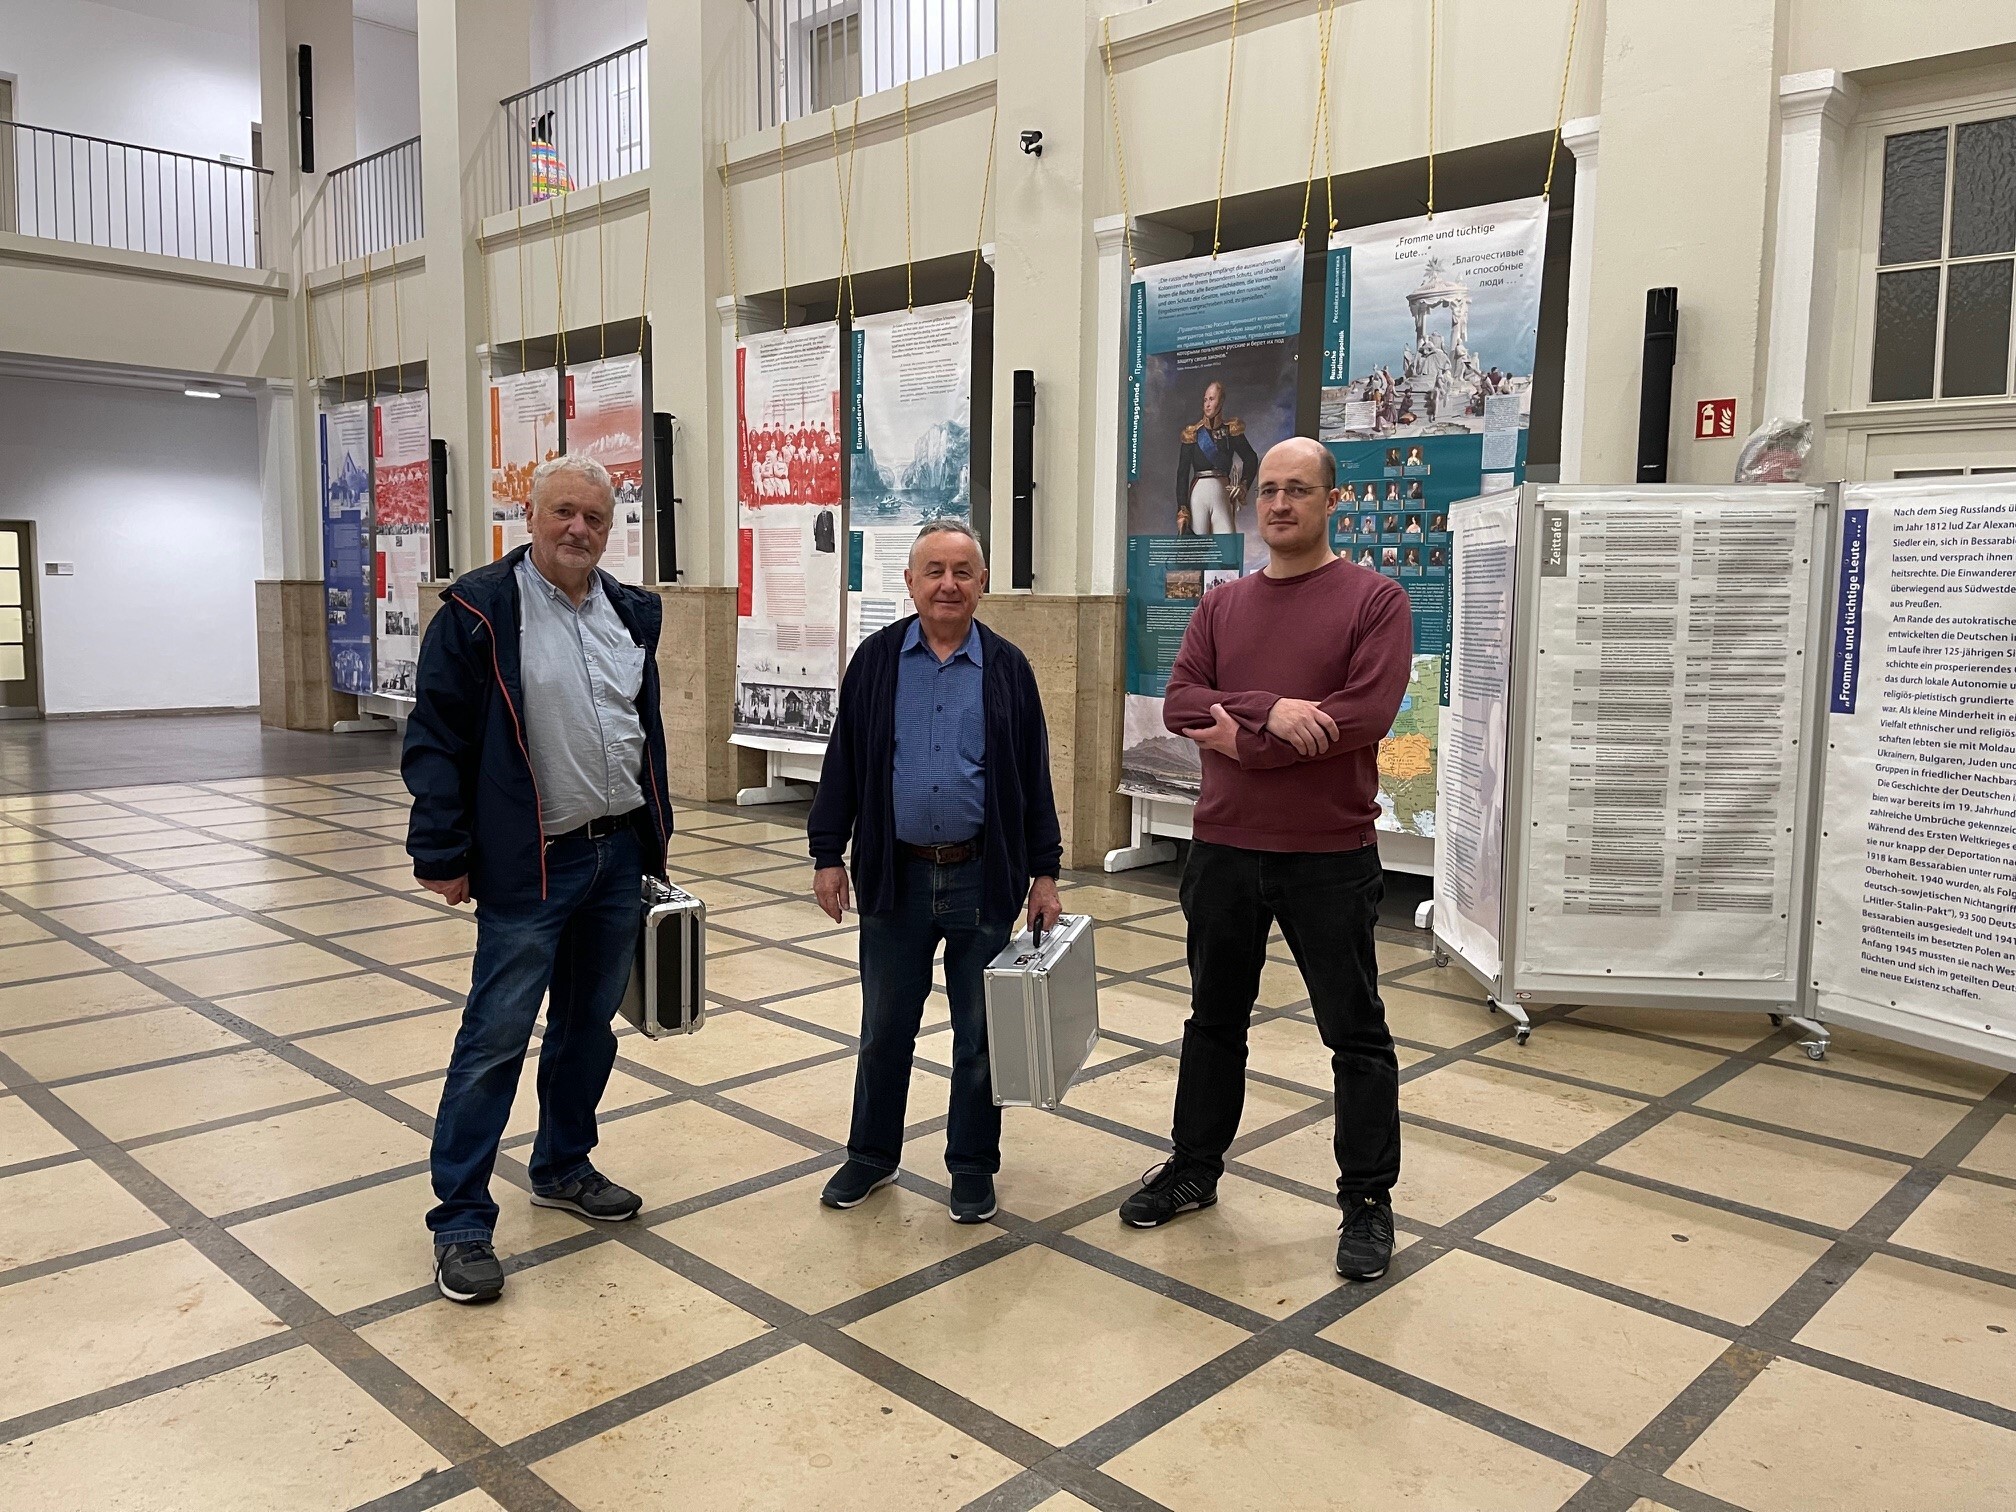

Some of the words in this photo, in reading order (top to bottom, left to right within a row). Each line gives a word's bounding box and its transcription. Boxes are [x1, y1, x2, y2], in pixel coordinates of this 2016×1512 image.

[1436, 228, 1454, 240] und
[1456, 223, 1496, 237] tüchtige
[1473, 262, 1524, 275] способные
[1479, 279, 1504, 288] люди
[1337, 330, 1345, 380] Siedlungspolitik
[1131, 382, 1140, 474] Auswanderungsgründe
[1894, 508, 1915, 516] Nach
[1917, 507, 1937, 515] dem
[1939, 507, 1958, 517] Sieg
[1960, 504, 2006, 514] Russlands
[1905, 522, 1924, 533] Jahr
[1925, 521, 1947, 531] 1812
[1949, 521, 1964, 531] lud
[1965, 521, 1981, 530] Zar
[1550, 518, 1562, 566] Zeittafel
[1893, 537, 1921, 547] Siedler
[1922, 537, 1939, 548] ein,
[1940, 536, 1958, 546] sich
[1959, 536, 1969, 546] in
[1848, 540, 1860, 574] Leute
[1893, 554, 1919, 562] lassen,
[1921, 553, 1938, 561] und
[1939, 551, 1984, 564] versprach
[1986, 552, 2013, 561] ihnen
[1891, 569, 1939, 577] heitsrechte.
[1941, 569, 1956, 577] Die
[1891, 583, 1945, 595] überwiegend
[1946, 585, 1963, 593] aus
[1845, 574, 1860, 626] tüchtige
[1905, 599, 1942, 608] Preußen.
[1893, 613, 1906, 623] Am
[1907, 613, 1934, 624] Rande
[1935, 615, 1950, 624] des
[1843, 628, 1855, 650] und
[1888, 628, 1940, 640] entwickelten
[1940, 630, 1955, 640] die
[1957, 630, 2008, 641] Deutschen
[1887, 644, 1897, 653] im
[1898, 644, 1922, 654] Laufe
[1922, 644, 1943, 655] ihrer
[1944, 645, 2004, 660] 125-jährigen
[1886, 659, 1919, 669] schichte
[1919, 661, 1932, 670] ein
[1934, 661, 2012, 675] prosperierendes
[1885, 674, 1899, 683] das
[1899, 674, 1923, 685] durch
[1925, 676, 1949, 686] lokale
[1951, 677, 2007, 689] Autonomie
[1884, 690, 1958, 705] religiös-pietistisch
[1959, 693, 2014, 707] grundierte
[1899, 706, 1911, 714] Als
[1913, 706, 1937, 717] kleine
[1938, 707, 1995, 720] Minderheit
[1996, 710, 2006, 721] in
[1881, 719, 1907, 729] Vielfalt
[1909, 722, 1955, 733] ethnischer
[1957, 724, 1977, 735] und
[1879, 734, 1911, 745] schaften
[1913, 737, 1941, 748] lebten
[1944, 739, 1957, 749] sie
[1959, 739, 1977, 751] mit
[1878, 747, 1917, 763] Ukrainern,
[1919, 752, 1966, 767] Bulgaren,
[1967, 755, 1998, 770] Juden
[1875, 764, 1909, 777] Gruppen
[1911, 767, 1920, 776] in
[1920, 768, 1972, 781] friedlicher
[1878, 777, 1891, 788] Die
[1891, 778, 1941, 794] Geschichte
[1941, 784, 1959, 796] der
[1962, 787, 2011, 801] Deutschen
[1872, 792, 1888, 802] bien
[1890, 797, 1906, 805] war
[1908, 796, 1941, 809] bereits
[1942, 799, 1955, 810] im
[1959, 801, 1973, 812] 19.
[1870, 809, 1912, 821] zahlreiche
[1914, 811, 1966, 827] Umbrüche
[1868, 822, 1906, 836] Während
[1908, 827, 1924, 837] des
[1927, 828, 1958, 841] Ersten
[1959, 832, 2011, 852] Weltkrieges
[1867, 837, 1877, 846] sie
[1879, 839, 1894, 848] nur
[1895, 838, 1926, 854] knapp
[1928, 843, 1946, 855] der
[1947, 845, 2001, 866] Deportation
[1867, 851, 1886, 862] 1918
[1888, 852, 1908, 866] kam
[1909, 856, 1967, 874] Bessarabien
[1968, 864, 1992, 877] unter
[1866, 865, 1918, 881] Oberhoheit.
[1920, 872, 1944, 885] 1940
[1945, 875, 1982, 893] wurden,
[1983, 885, 1995, 894] als
[1864, 880, 1962, 906] deutsch-sowjetischen
[1862, 909, 1915, 925] Bessarabien
[1917, 918, 1973, 939] ausgesiedelt
[1974, 927, 1993, 941] und
[1959, 909, 1970, 921] 93
[1970, 912, 1987, 924] 500
[1862, 925, 1916, 942] größtenteils
[1917, 931, 1930, 943] im
[1931, 933, 1973, 952] besetzten
[1974, 943, 2001, 958] Polen
[1862, 938, 1893, 952] Anfang
[1895, 945, 1917, 955] 1945
[1919, 950, 1955, 963] mussten
[1958, 957, 1970, 967] sie
[1970, 958, 1994, 973] nach
[1861, 951, 1896, 966] flüchten
[1897, 956, 1916, 970] und
[1918, 961, 1935, 974] sich
[1937, 967, 1948, 977] im
[1950, 973, 1989, 986] geteilten
[1861, 967, 1878, 976] eine
[1880, 972, 1902, 982] neue
[1904, 975, 1940, 990] Existenz
[1942, 986, 1981, 1000] schaffen.
